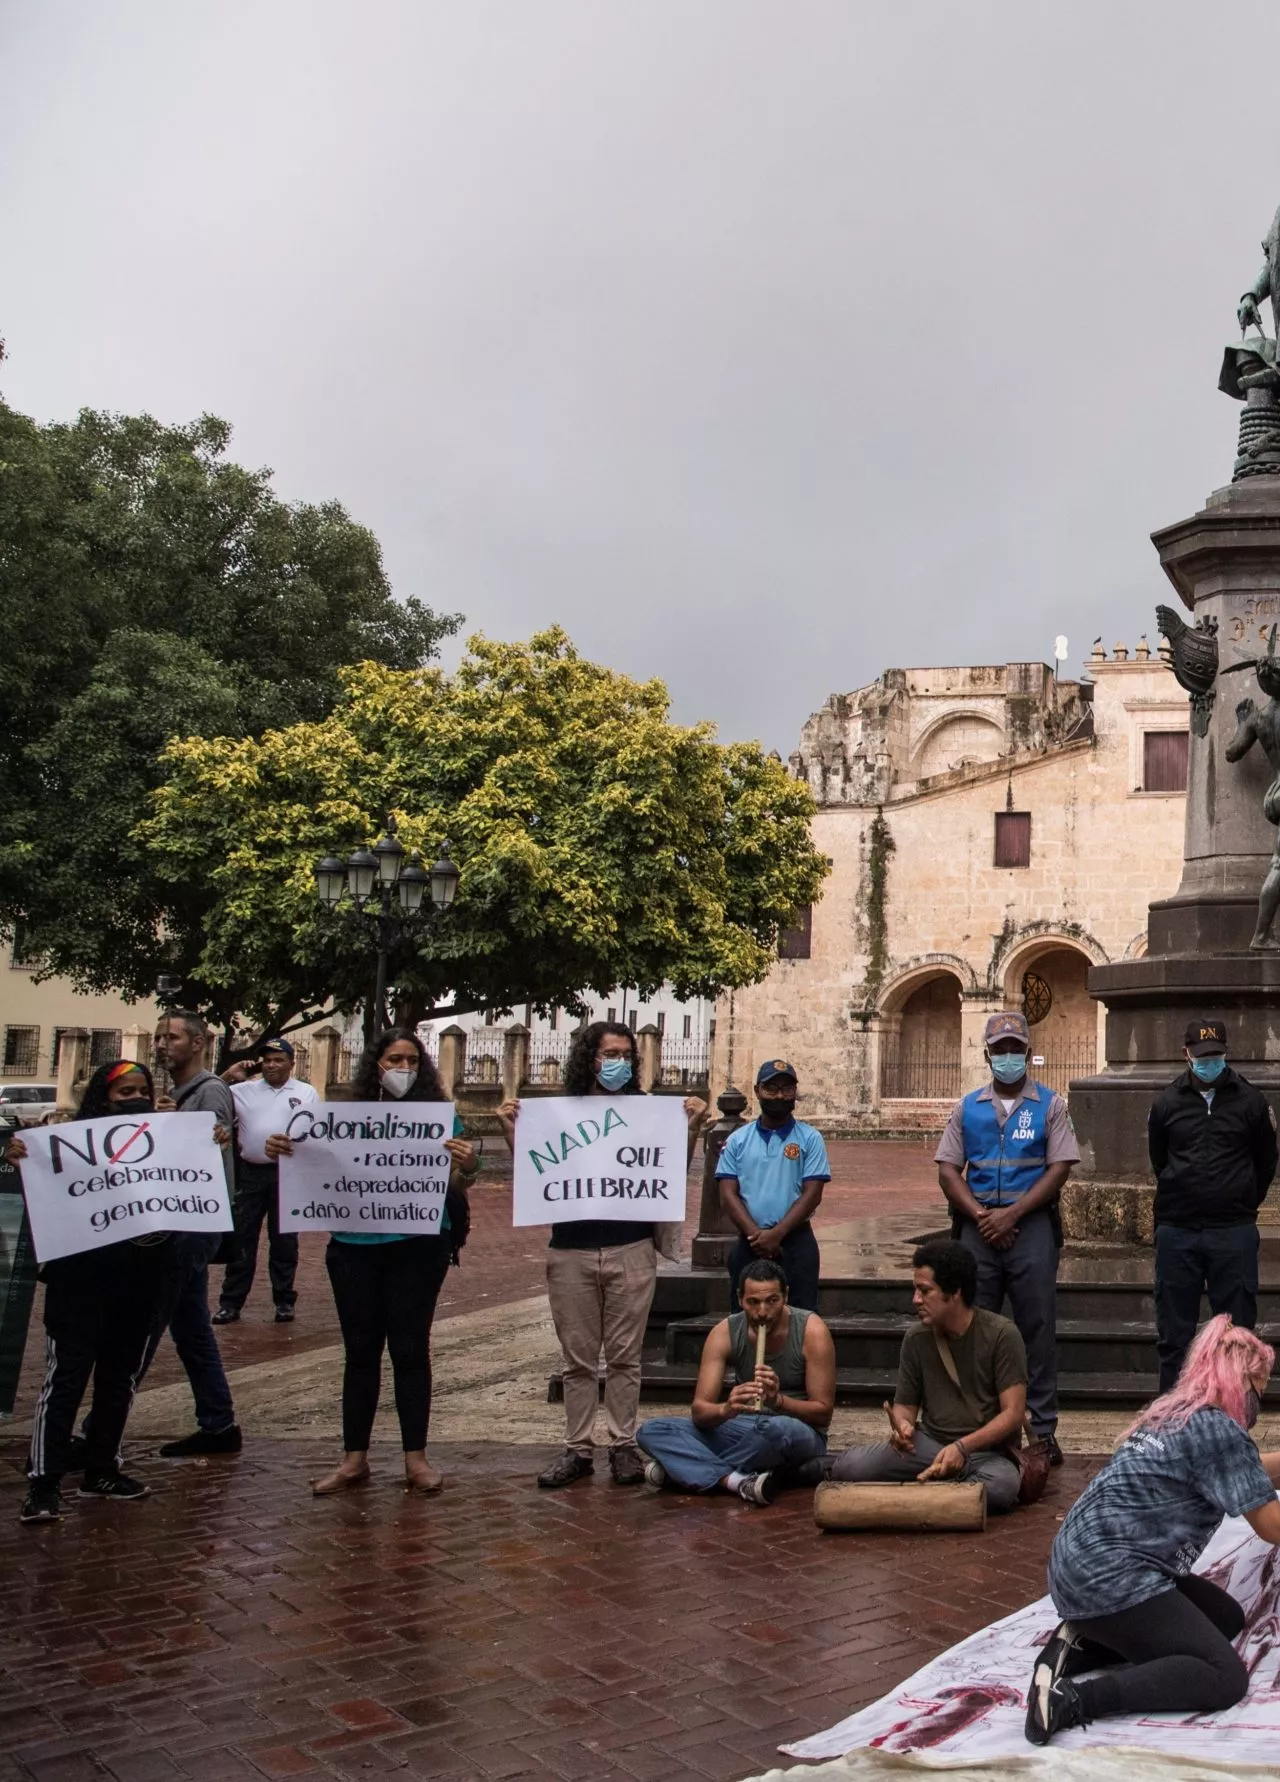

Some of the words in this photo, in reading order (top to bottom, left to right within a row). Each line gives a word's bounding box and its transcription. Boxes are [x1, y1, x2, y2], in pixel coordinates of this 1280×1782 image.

[286, 1110, 445, 1143] Colonialismo
[1012, 1129, 1035, 1140] ADN
[49, 1123, 155, 1174] NO
[528, 1107, 629, 1175] NADA
[364, 1149, 449, 1167] racismo
[616, 1146, 667, 1168] QUE
[68, 1166, 213, 1197] celebramos
[335, 1175, 446, 1198] depredación
[543, 1177, 669, 1201] CELEBRAR
[90, 1195, 220, 1233] genocidio
[303, 1201, 350, 1219] daño
[359, 1201, 440, 1222] climático
